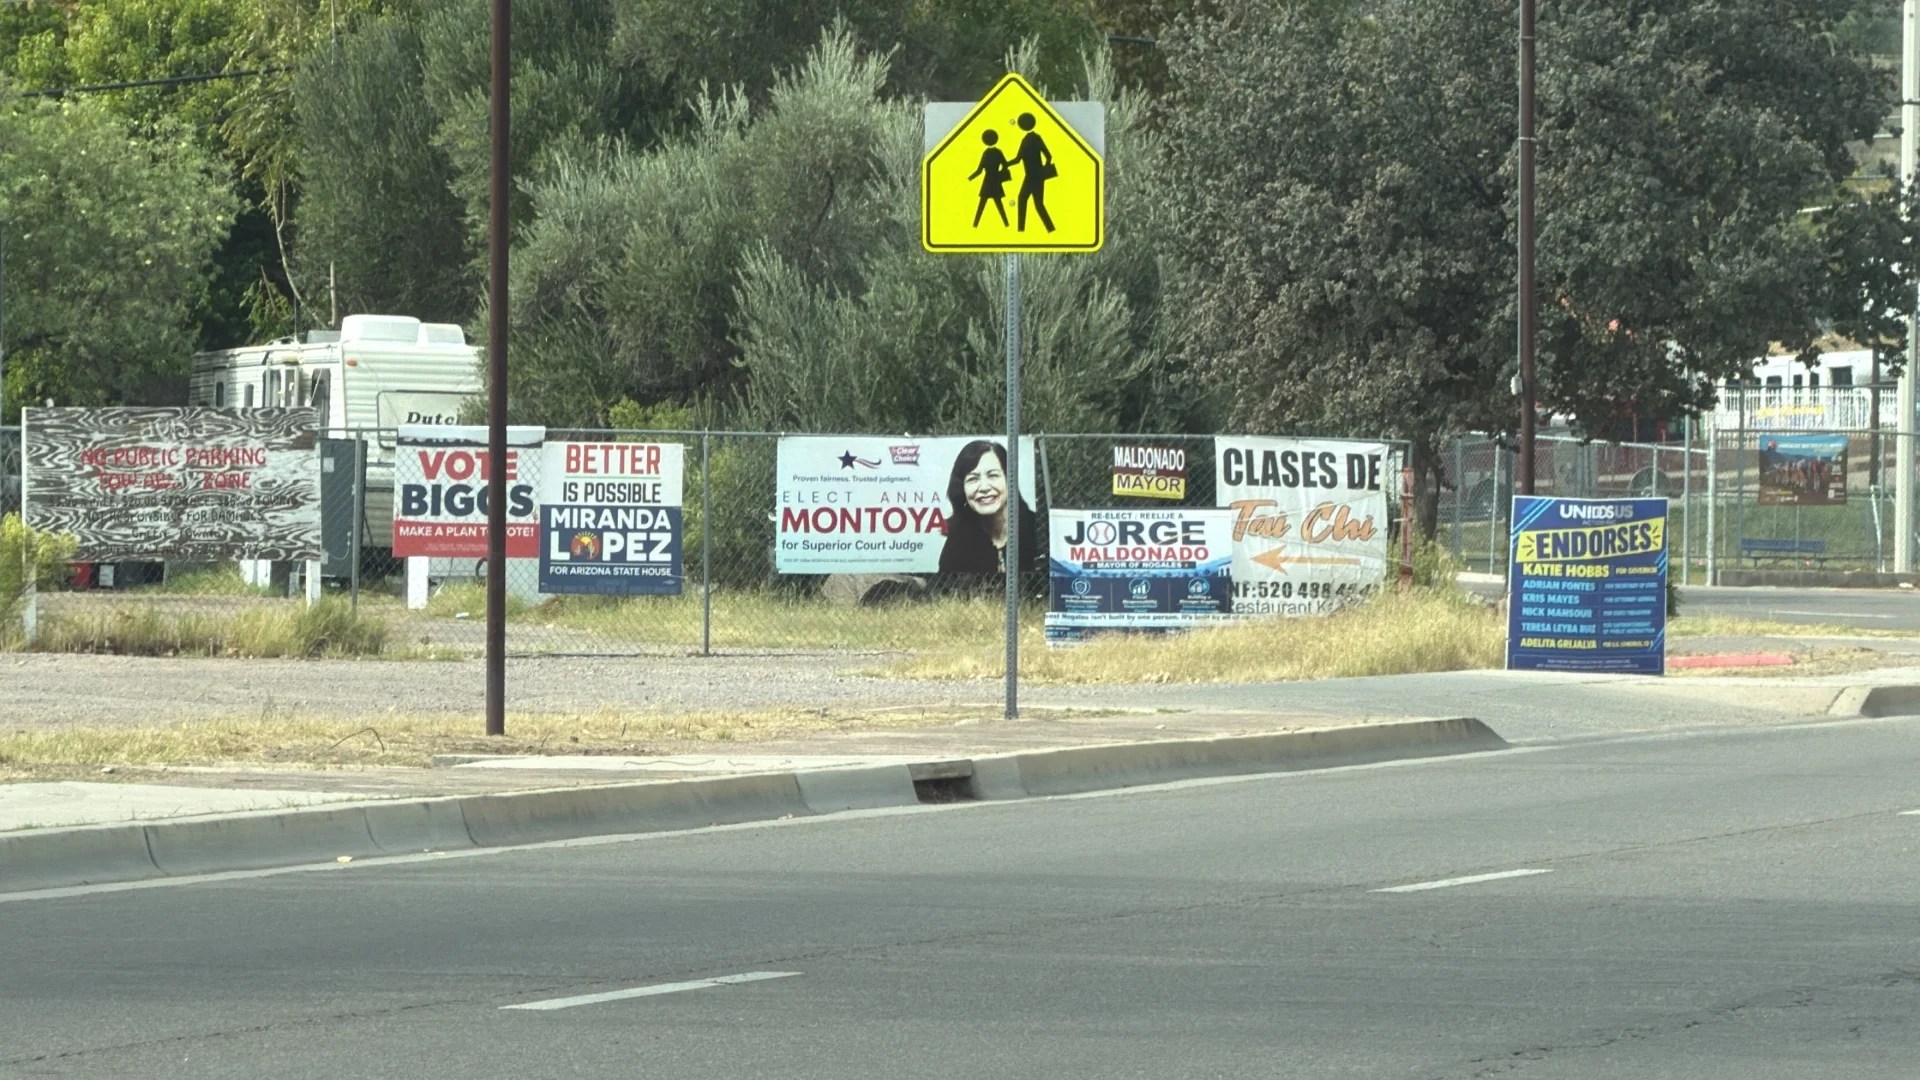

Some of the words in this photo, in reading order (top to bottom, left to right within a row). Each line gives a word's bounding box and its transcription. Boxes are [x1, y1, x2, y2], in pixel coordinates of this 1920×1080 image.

[81, 448, 107, 466] NO
[114, 448, 179, 466] PUBLIC
[185, 448, 267, 467] PARKING
[565, 444, 661, 475] BETTER
[1114, 446, 1185, 471] MALDONADO
[1143, 468, 1157, 476] FOR
[1223, 447, 1338, 489] CLASES
[1346, 453, 1382, 491] DE
[99, 471, 137, 490] TOW
[203, 471, 251, 489] ZONE
[792, 475, 819, 483] Proven
[820, 474, 850, 483] fairness.
[852, 475, 878, 483] Trusted
[879, 475, 913, 485] judgment.
[1117, 475, 1181, 492] MAYOR
[562, 481, 579, 503] IS
[583, 482, 662, 504] POSSIBLE
[782, 491, 853, 504] ELECT
[880, 491, 941, 504] ANNA
[186, 510, 208, 521] FOR
[550, 507, 672, 530] MIRANDA
[781, 506, 949, 536] MONTOYA
[1091, 512, 1132, 521] RE-ELECT
[1140, 512, 1175, 520] REELIJE
[1230, 500, 1292, 542] Tai
[1300, 501, 1378, 544] Chi
[399, 526, 432, 537] MAKE
[434, 526, 444, 536] A
[446, 526, 477, 537] PLAN
[505, 526, 534, 537] OTE!
[1064, 520, 1206, 546] JORGE
[782, 540, 799, 551] for
[802, 540, 851, 553] Superior
[855, 540, 887, 551] Court
[889, 540, 924, 553] Judge
[1535, 522, 1652, 560] ENDORSES
[1070, 547, 1209, 562] MALDONADO
[549, 566, 568, 576] FOR
[569, 566, 612, 577] ARIZONA
[612, 566, 640, 577] STATE
[641, 567, 672, 577] HOUSE
[1096, 561, 1127, 570] MAYOR
[1129, 561, 1140, 569] OF
[1142, 561, 1182, 570] NOGALES
[1522, 563, 1563, 576] KATIE
[1565, 565, 1610, 578] HOBBS
[1522, 580, 1560, 590] ADRIAN
[1561, 581, 1596, 592] FONTES
[1522, 593, 1545, 603] KRIS
[1547, 594, 1580, 605] MAYES
[1061, 614, 1089, 622] Nogales
[1127, 614, 1136, 622] by
[1521, 607, 1545, 617] NICK
[1547, 608, 1593, 618] MANSOUR
[1521, 622, 1551, 633] TERESA
[1552, 623, 1578, 634] LEYBA
[1520, 637, 1556, 648] ADELITA
[1557, 638, 1598, 649] GRIJALVA
